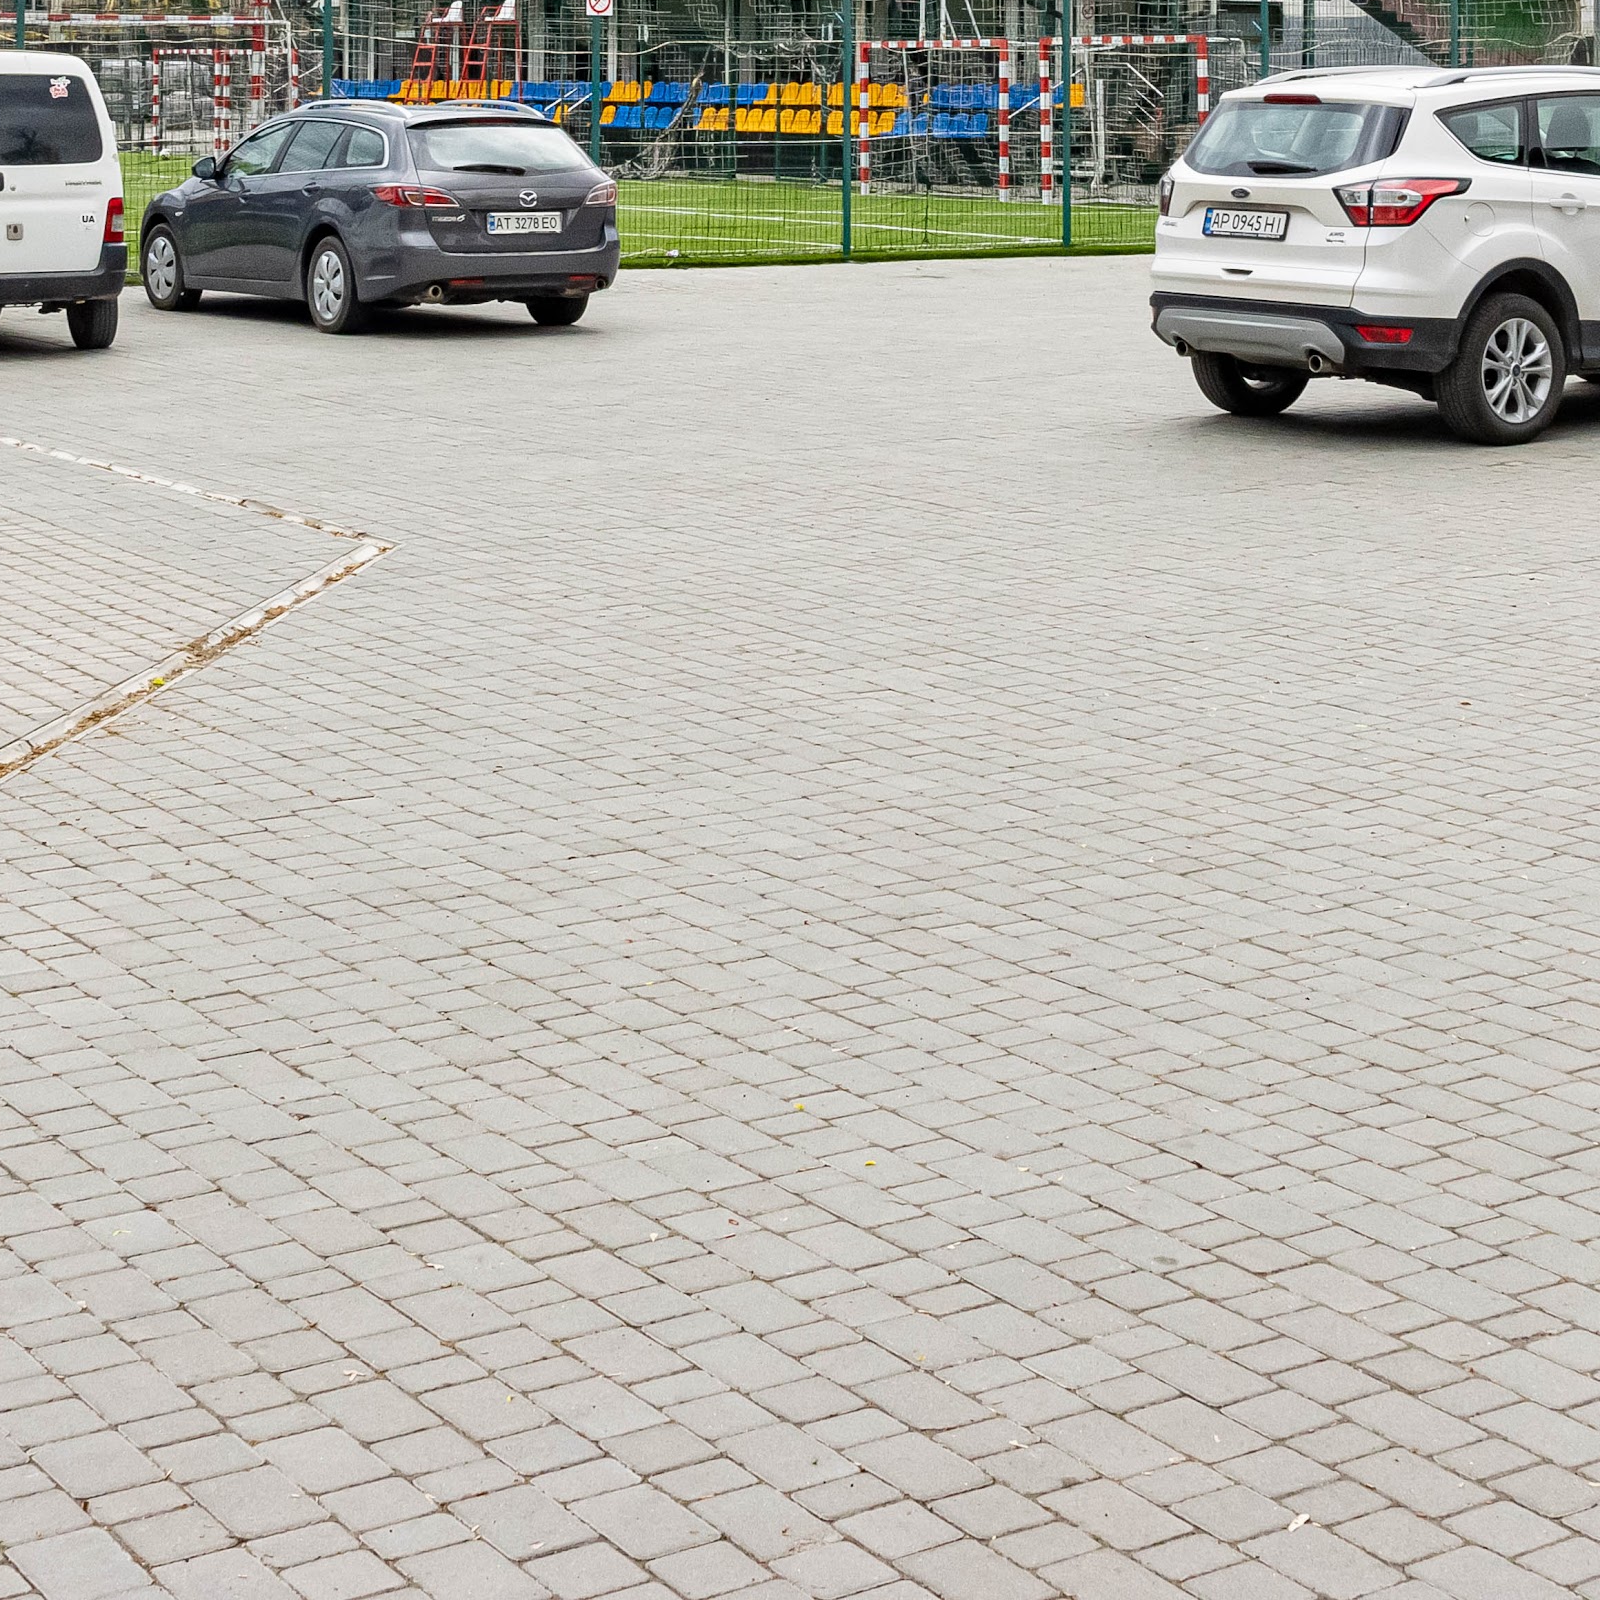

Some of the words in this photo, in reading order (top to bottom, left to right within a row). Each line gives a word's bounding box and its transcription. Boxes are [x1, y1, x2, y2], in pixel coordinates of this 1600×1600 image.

[82, 215, 95, 223] UA
[496, 217, 511, 230] AT
[515, 217, 539, 229] 3278
[542, 217, 557, 229] EO
[1211, 213, 1230, 229] AP
[1232, 214, 1261, 232] 0945
[1264, 216, 1282, 234] HI
